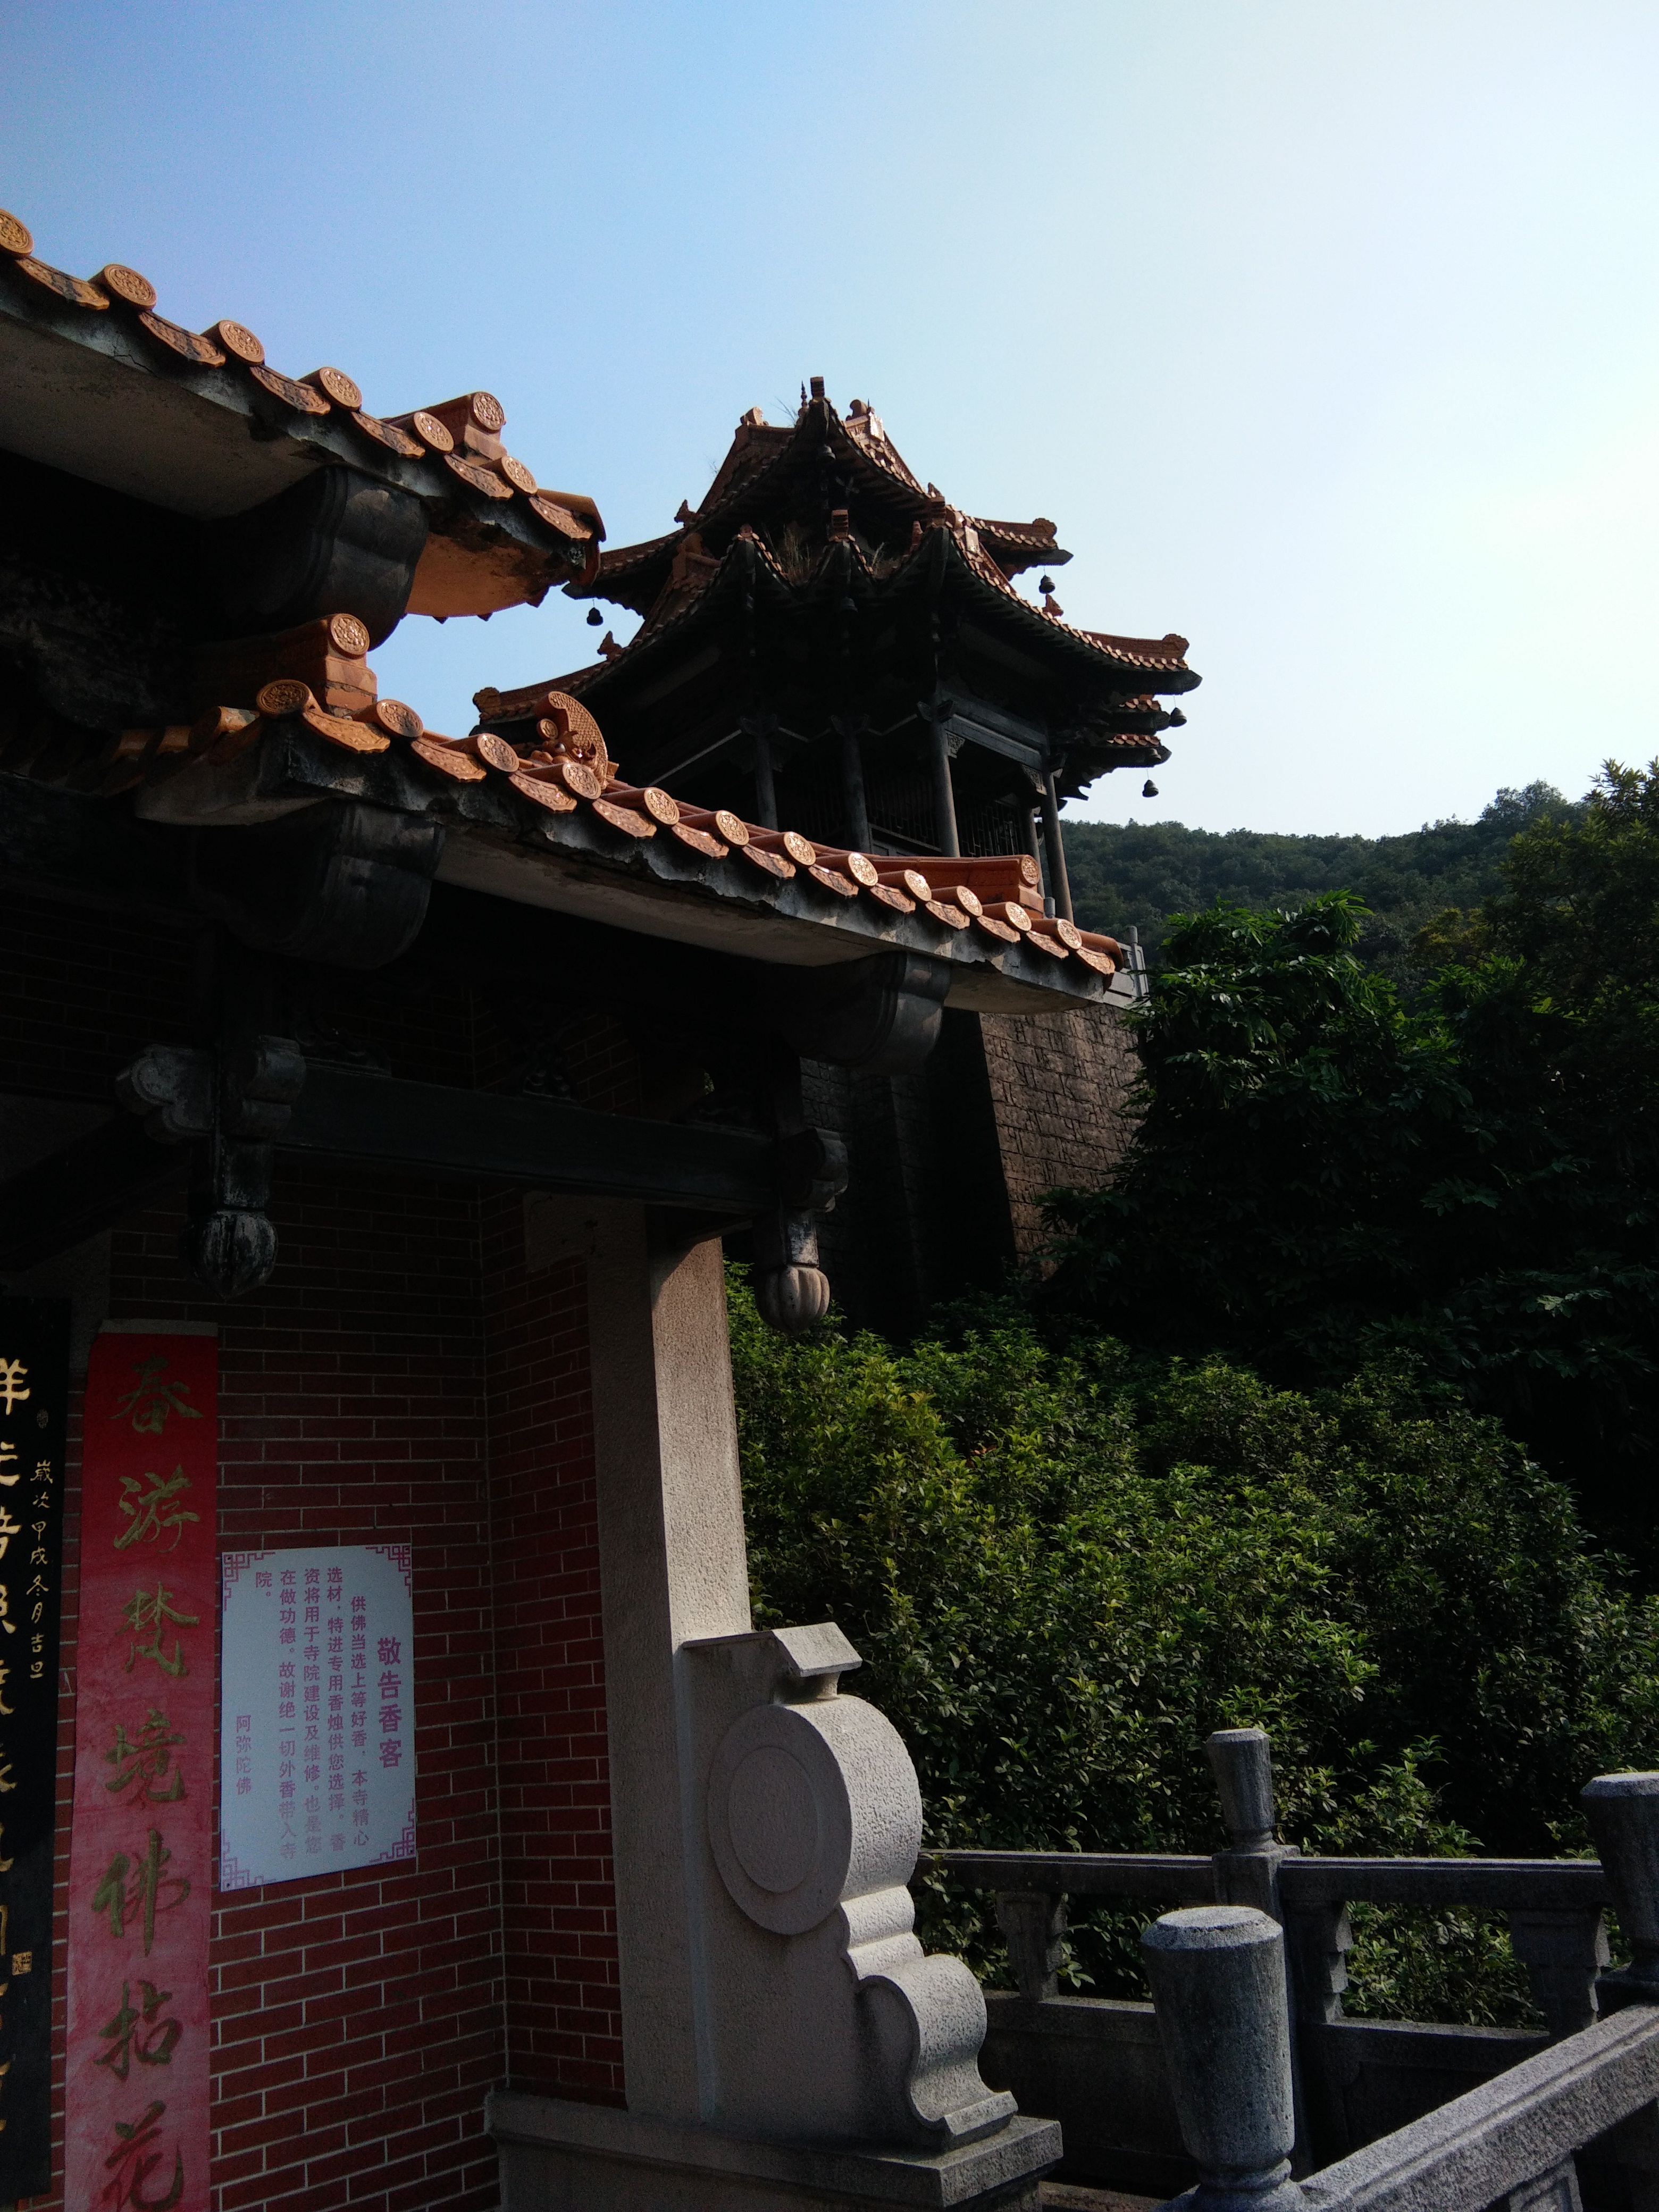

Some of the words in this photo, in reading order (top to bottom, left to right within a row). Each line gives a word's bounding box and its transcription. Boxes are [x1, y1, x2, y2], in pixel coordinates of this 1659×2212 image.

[235, 1714, 253, 1796] 阿弥陀佛
[376, 1637, 403, 1769] 敬告香客
